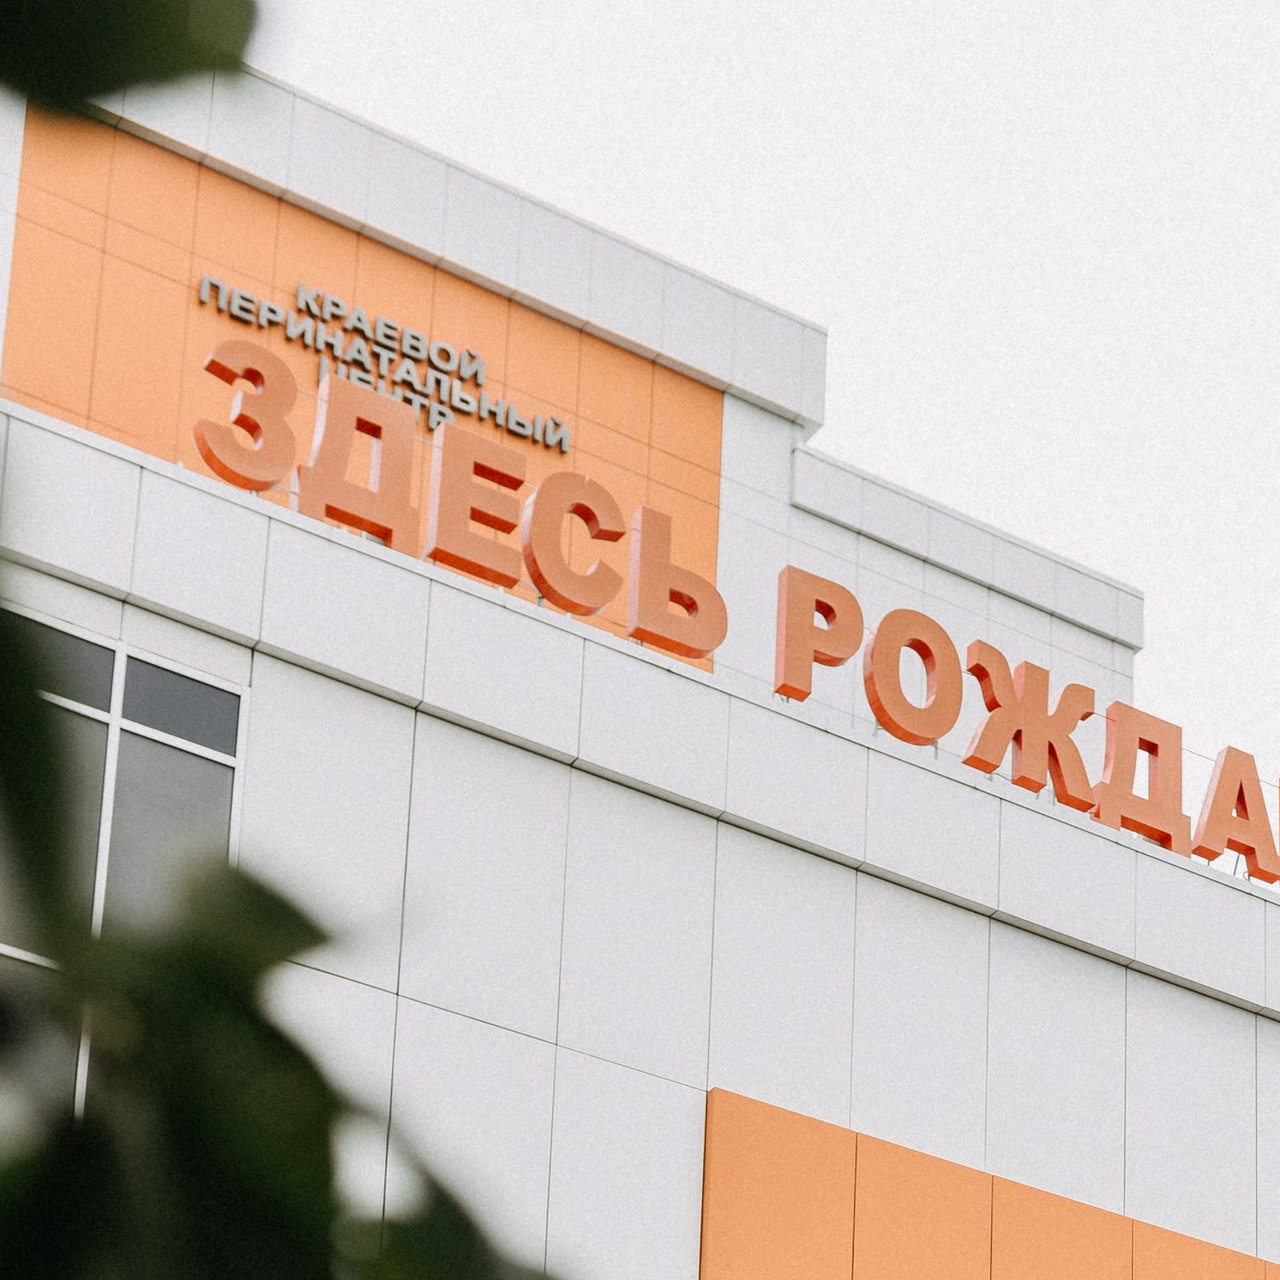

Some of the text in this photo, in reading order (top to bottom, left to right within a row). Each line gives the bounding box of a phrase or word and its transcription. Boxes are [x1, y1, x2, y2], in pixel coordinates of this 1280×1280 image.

[199, 275, 570, 455] ПЕРИНАТАЛЬНЫЙ
[295, 282, 487, 387] КРАЕВОЙ
[193, 339, 729, 659] ЗДЕСЬ
